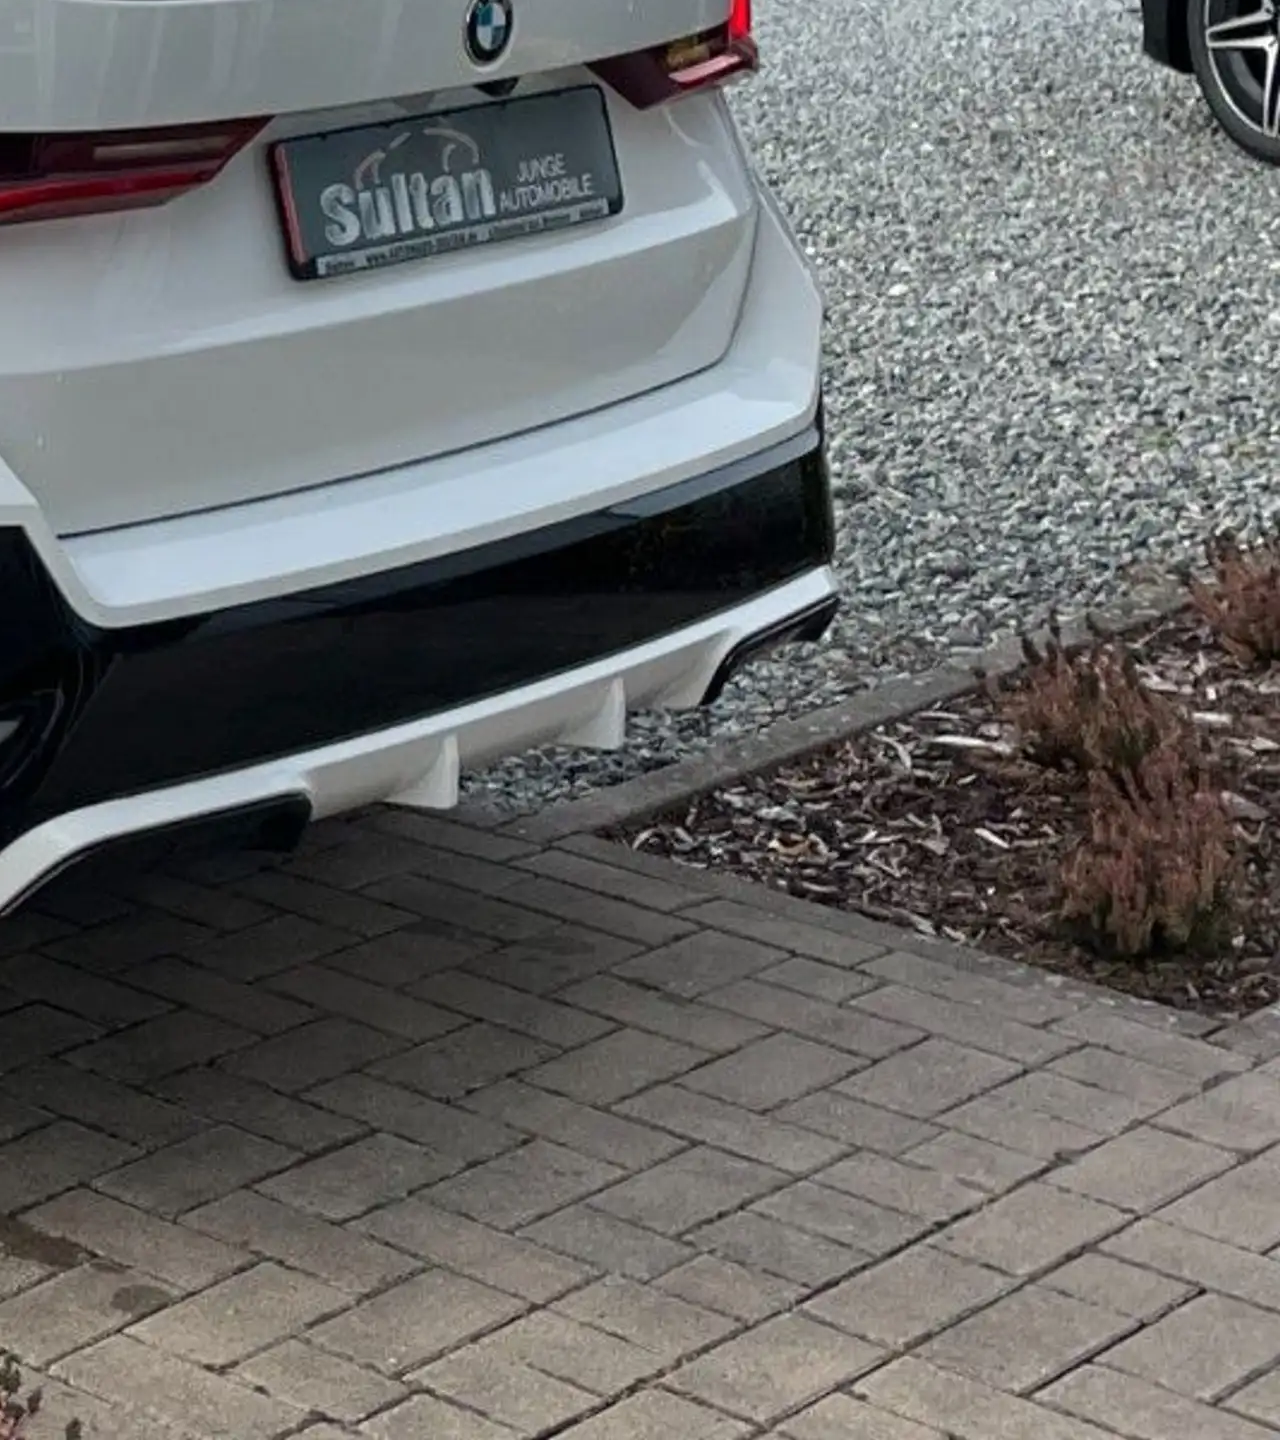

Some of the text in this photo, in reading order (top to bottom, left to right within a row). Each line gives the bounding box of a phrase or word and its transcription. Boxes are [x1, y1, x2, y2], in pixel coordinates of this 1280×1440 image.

[517, 153, 568, 183] JUNGE
[320, 168, 496, 246] Sultan
[500, 173, 596, 212] AUTOMOBILE
